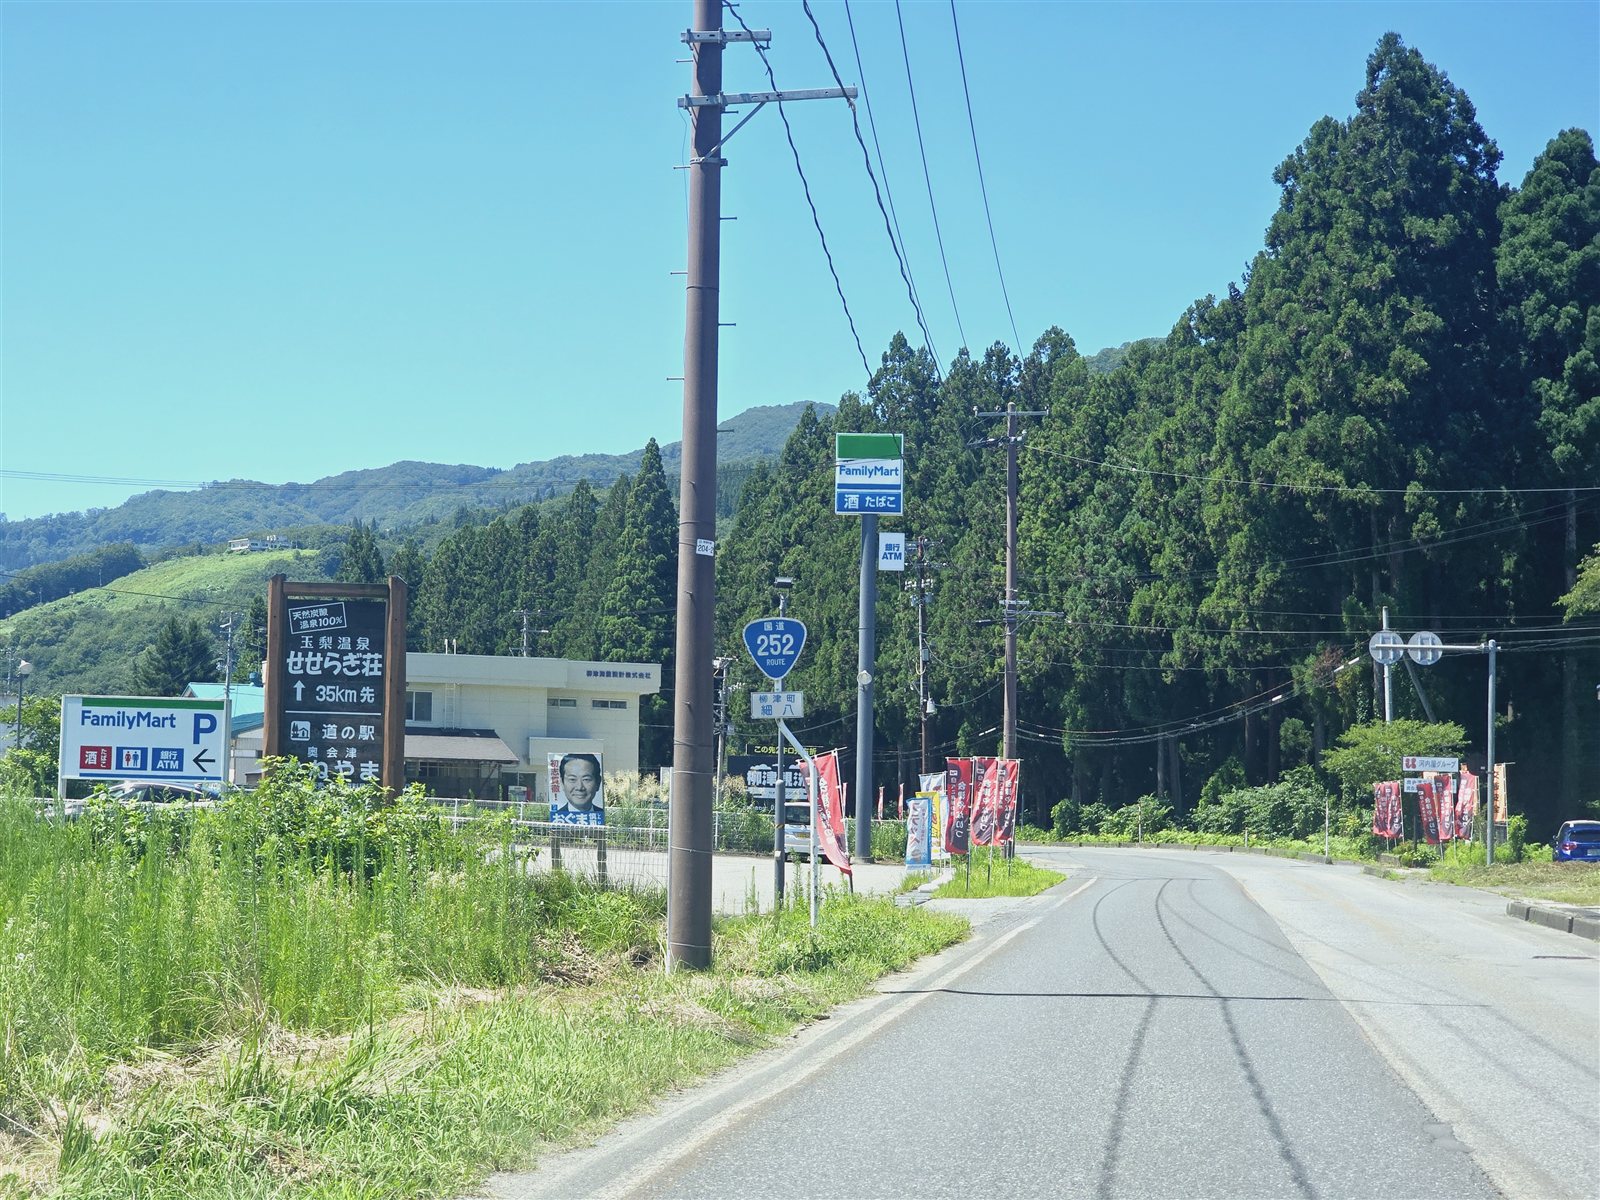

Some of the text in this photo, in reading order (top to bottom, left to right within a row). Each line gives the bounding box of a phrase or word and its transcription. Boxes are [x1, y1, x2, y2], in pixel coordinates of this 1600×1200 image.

[839, 464, 899, 478] FamilyMart
[844, 494, 896, 509] 酒 たばこ
[885, 543, 900, 552] 銀行
[881, 552, 902, 560] ATM
[292, 607, 328, 620] 天然炭酸
[300, 616, 343, 630] 温泉100%
[764, 621, 784, 631] 国道
[300, 635, 370, 650] 玉梨温泉
[756, 633, 795, 656] 252
[286, 650, 383, 676] せせらぎ荘
[766, 658, 786, 666] ROUTE
[759, 694, 796, 703] 柳津町
[761, 704, 794, 715] 細八
[81, 710, 176, 729] FamilyMart
[192, 713, 217, 744] P
[322, 724, 375, 740] 道の駅
[84, 750, 98, 765] 酒
[160, 750, 178, 760] 銀行
[307, 746, 357, 759] 奥会津
[156, 760, 179, 769] ATM
[552, 812, 588, 825] おぐま
